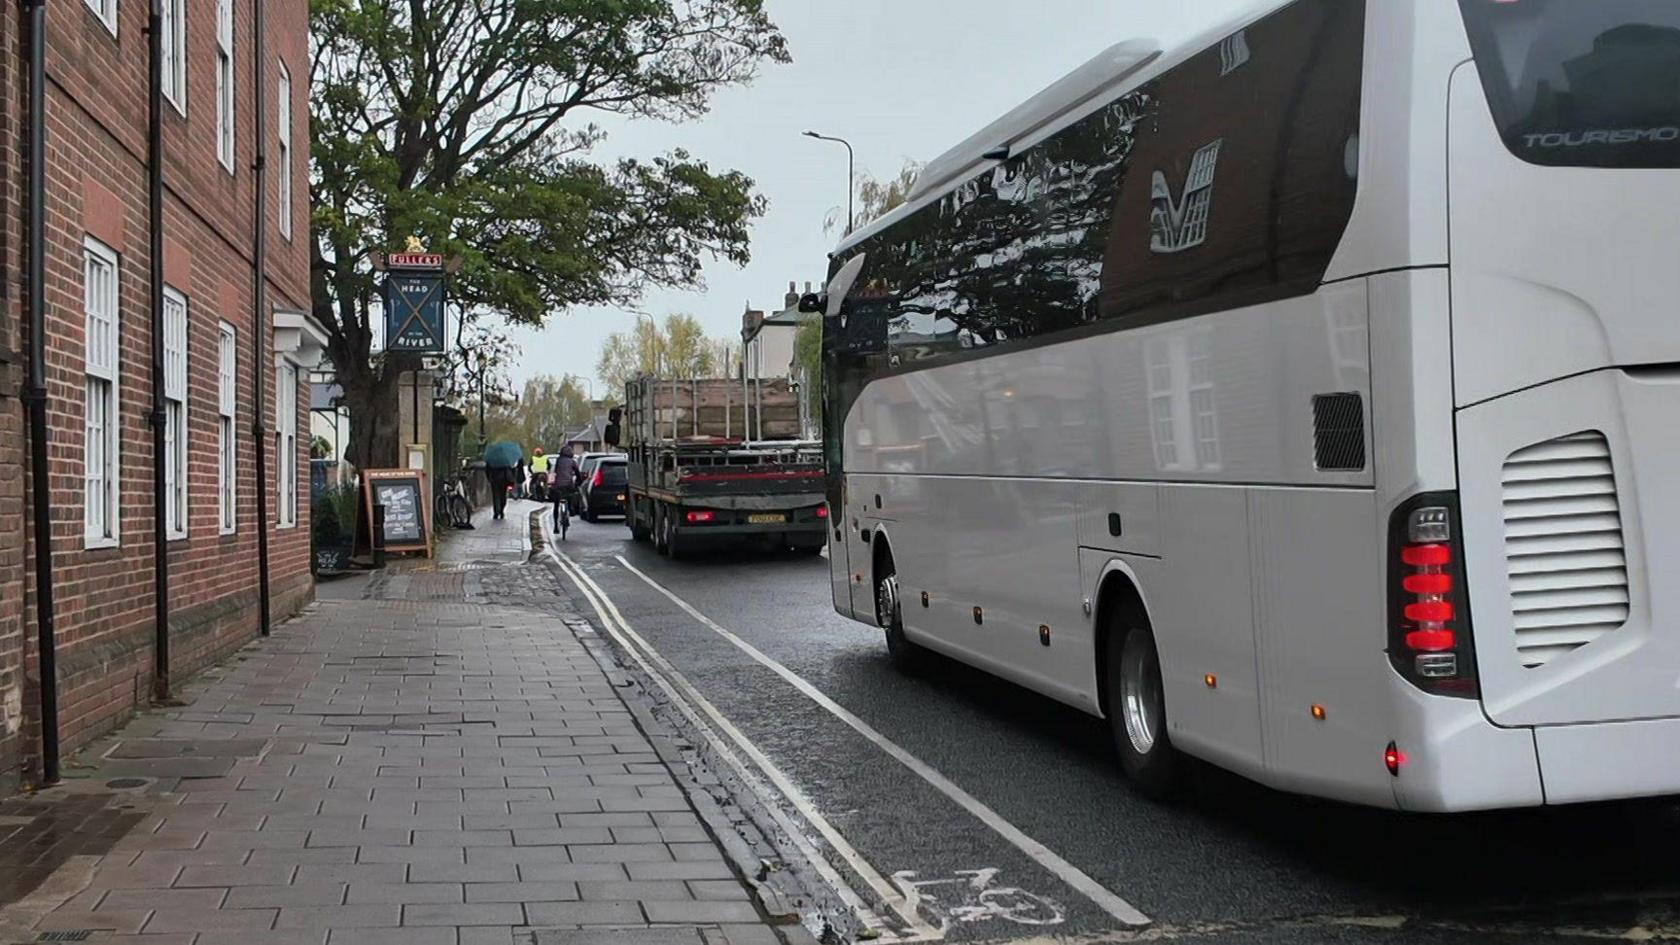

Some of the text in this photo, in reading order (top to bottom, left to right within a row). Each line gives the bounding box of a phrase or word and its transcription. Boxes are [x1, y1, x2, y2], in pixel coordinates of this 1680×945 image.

[1522, 127, 1679, 147] TOURISMO
[401, 285, 428, 293] HEAD
[398, 336, 433, 347] RIVER
